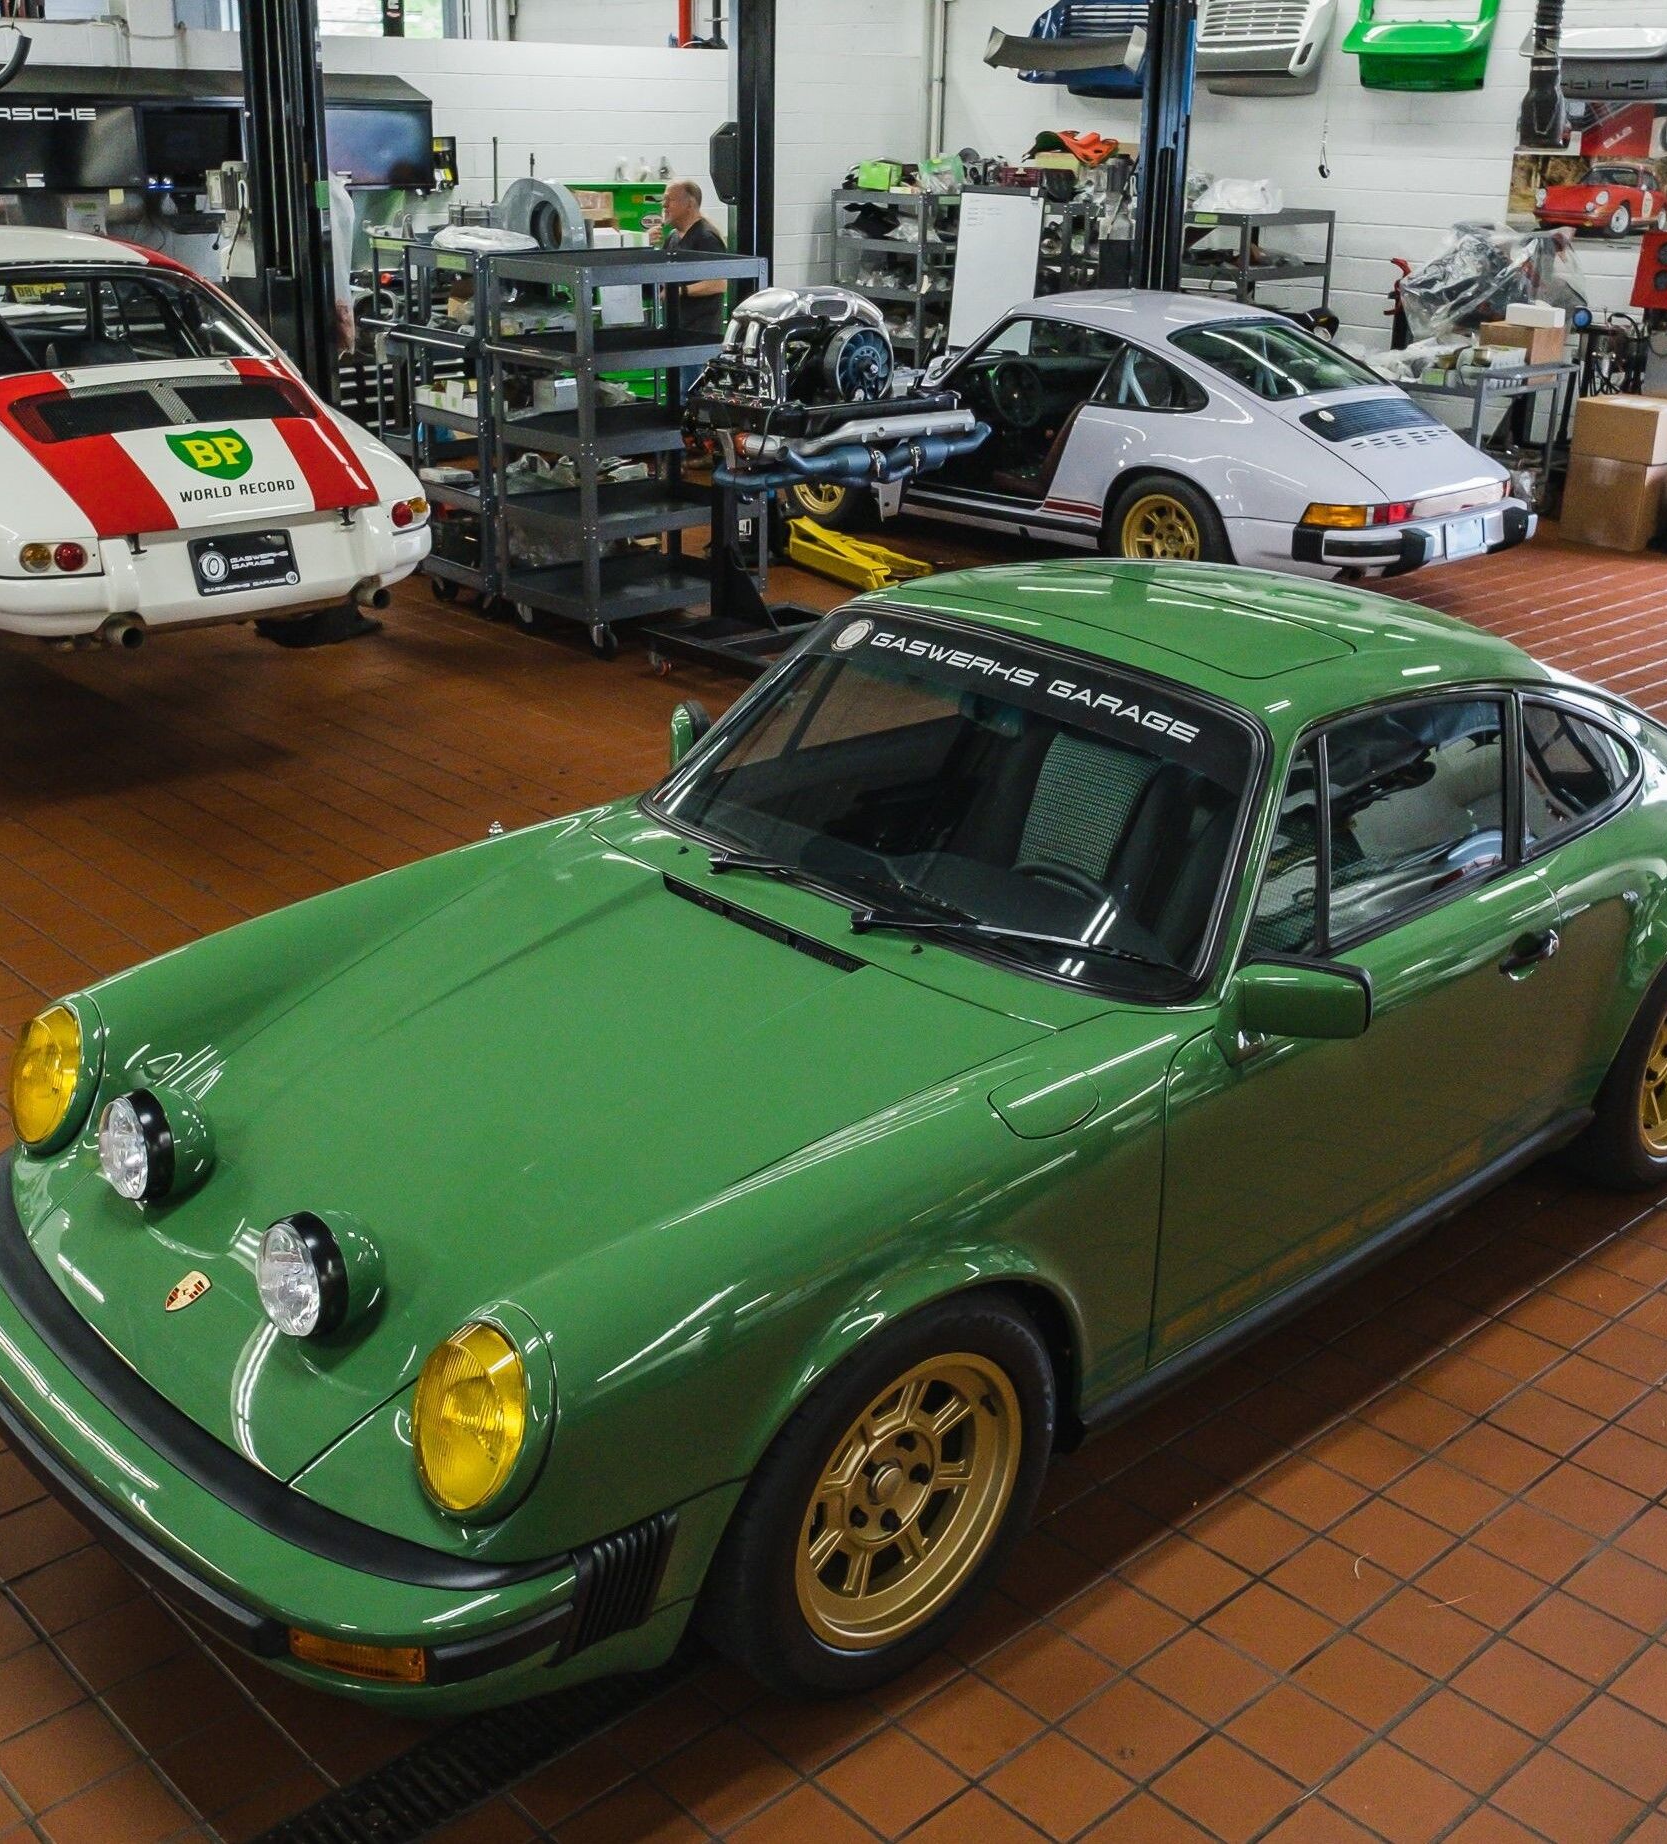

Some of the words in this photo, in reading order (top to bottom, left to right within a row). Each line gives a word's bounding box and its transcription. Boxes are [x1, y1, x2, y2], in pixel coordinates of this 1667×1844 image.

[180, 436, 244, 469] BP
[179, 486, 232, 503] WORLD
[239, 479, 295, 496] RECORD
[231, 558, 276, 570] GARAGE
[870, 632, 1040, 687] GASWERKS
[1046, 679, 1201, 744] GARAGE
